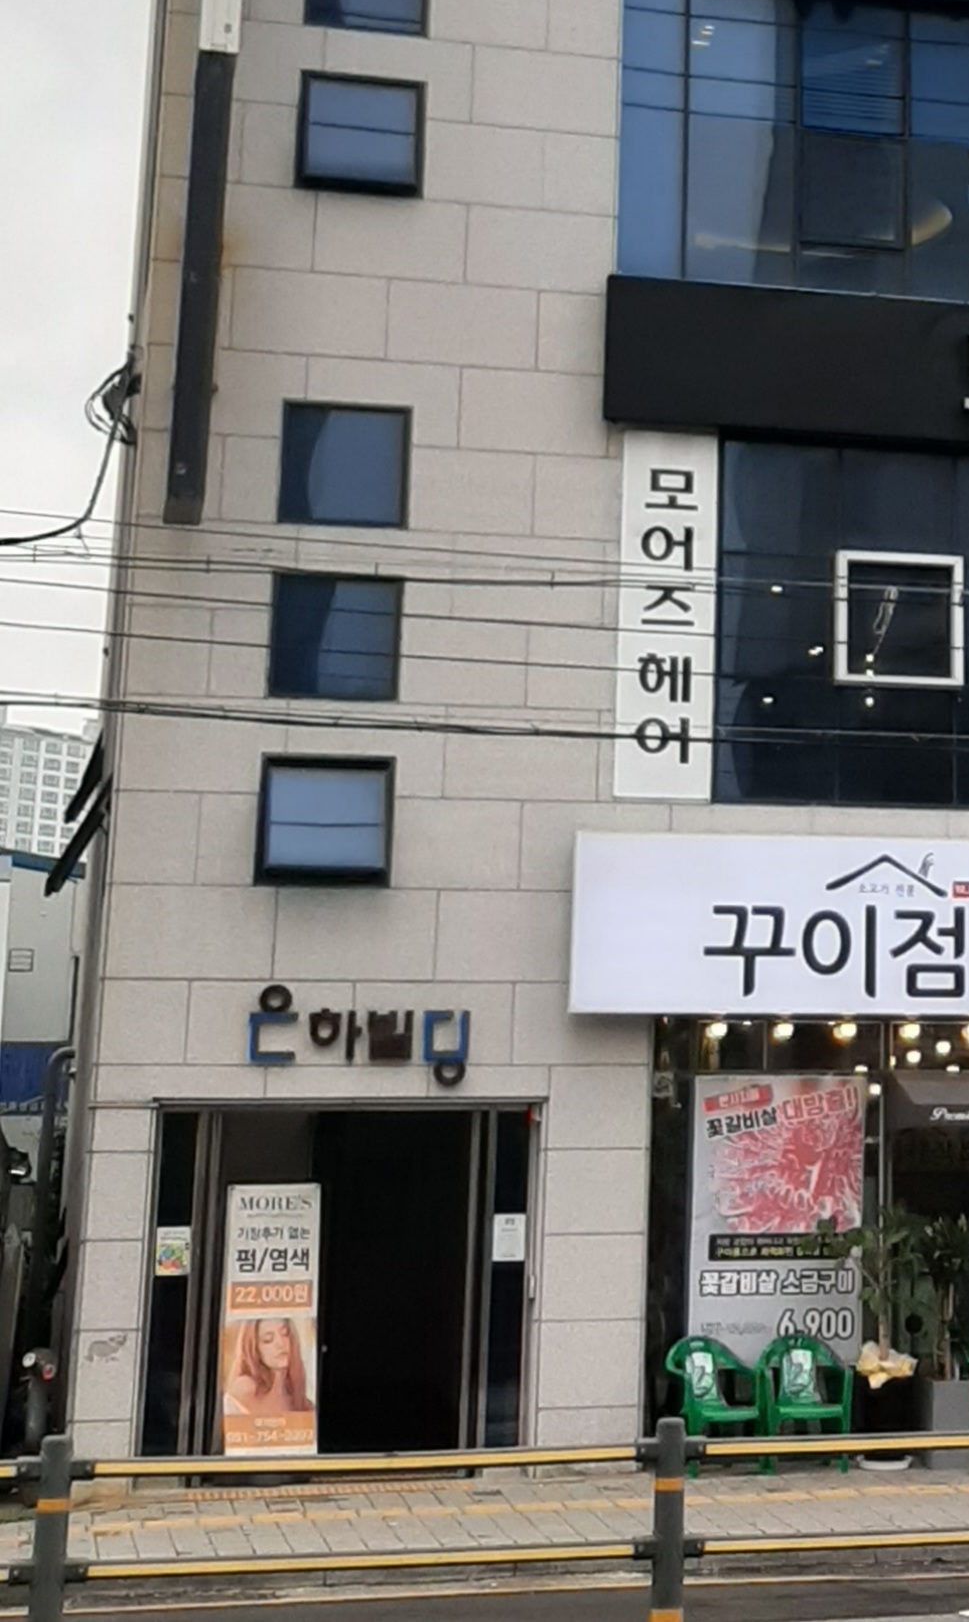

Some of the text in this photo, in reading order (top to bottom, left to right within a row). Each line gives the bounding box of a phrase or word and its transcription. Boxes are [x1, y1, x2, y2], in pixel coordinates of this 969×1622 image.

[287, 1225, 312, 1240] 없는
[236, 1247, 310, 1273] 펌/염색
[234, 1283, 309, 1304] 22,000원
[700, 1268, 856, 1297] 꽃갈비살 소금구이
